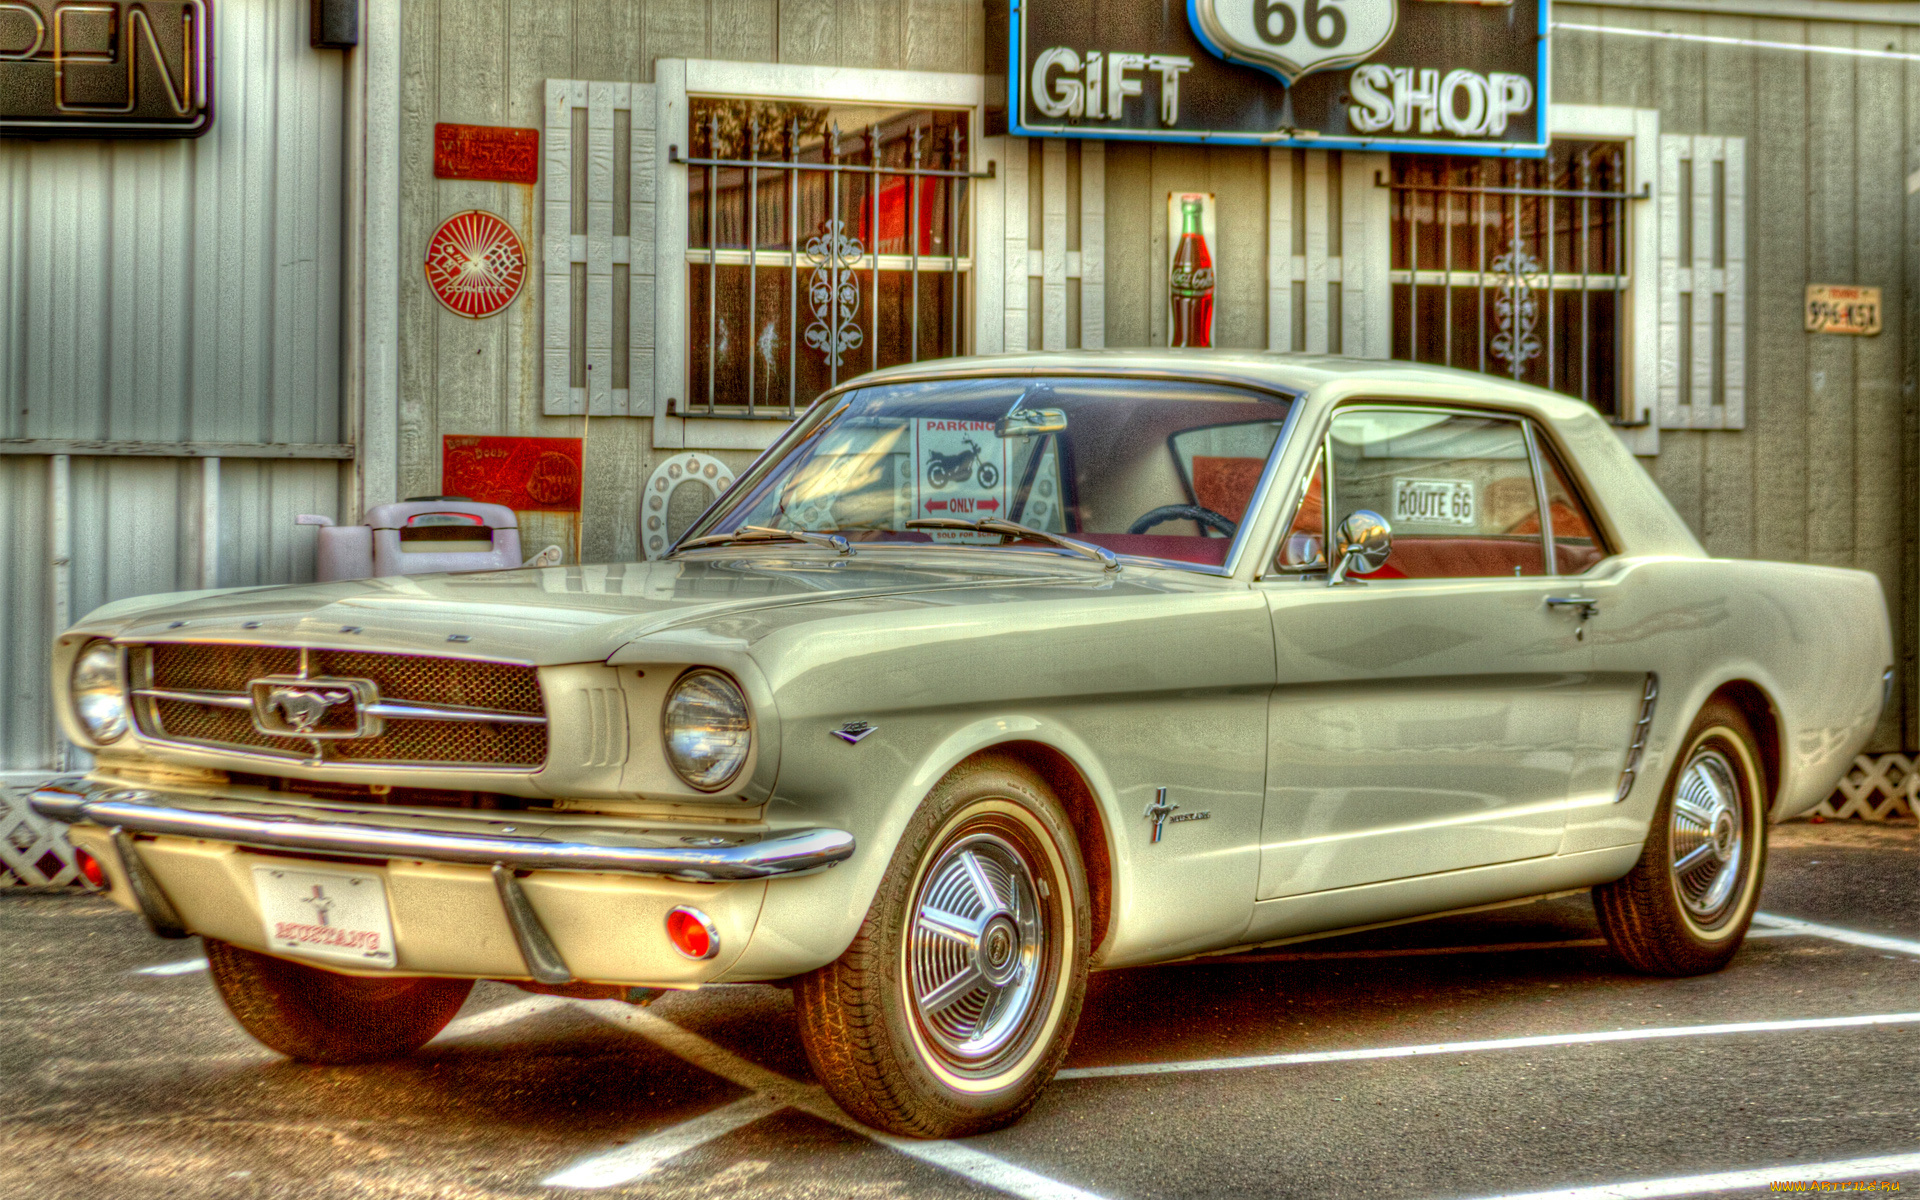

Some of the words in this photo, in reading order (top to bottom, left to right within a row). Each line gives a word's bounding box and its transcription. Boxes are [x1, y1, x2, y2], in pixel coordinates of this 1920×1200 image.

[1253, 0, 1347, 48] 66
[1031, 46, 1194, 127] GIFT
[1349, 64, 1533, 137] SHOP
[446, 285, 506, 293] CORVETTE
[927, 421, 995, 431] PARKING
[950, 498, 975, 513] ONLY
[1397, 490, 1446, 516] ROUTE
[1452, 492, 1471, 518] 66
[275, 922, 381, 950] MUSTANG
